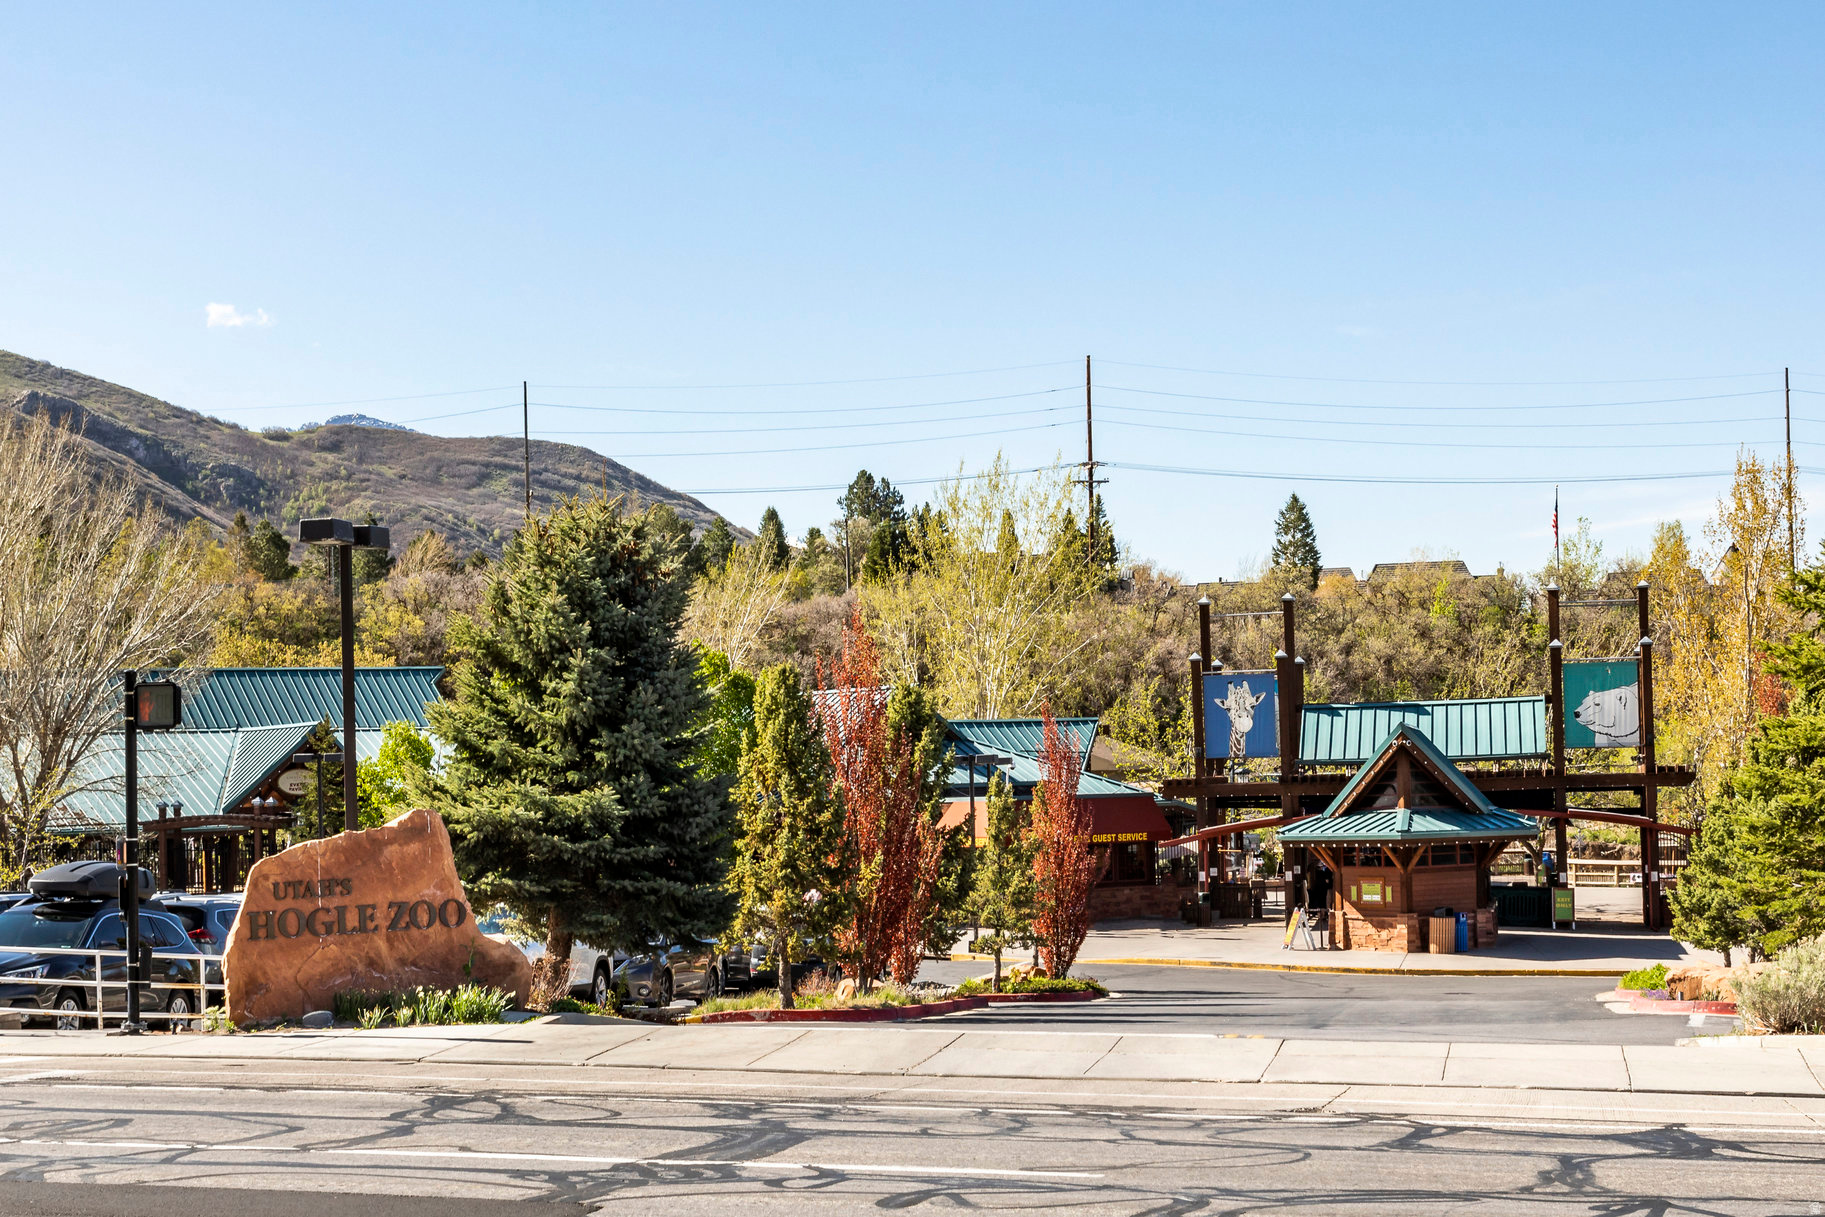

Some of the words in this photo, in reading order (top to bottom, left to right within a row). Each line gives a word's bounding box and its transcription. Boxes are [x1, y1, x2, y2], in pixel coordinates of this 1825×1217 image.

[1092, 834, 1117, 843] GUEST
[1117, 832, 1148, 842] SERVICE
[272, 878, 352, 901] UTAH'S
[247, 903, 379, 941] HOGLE
[387, 898, 467, 932] ZOO
